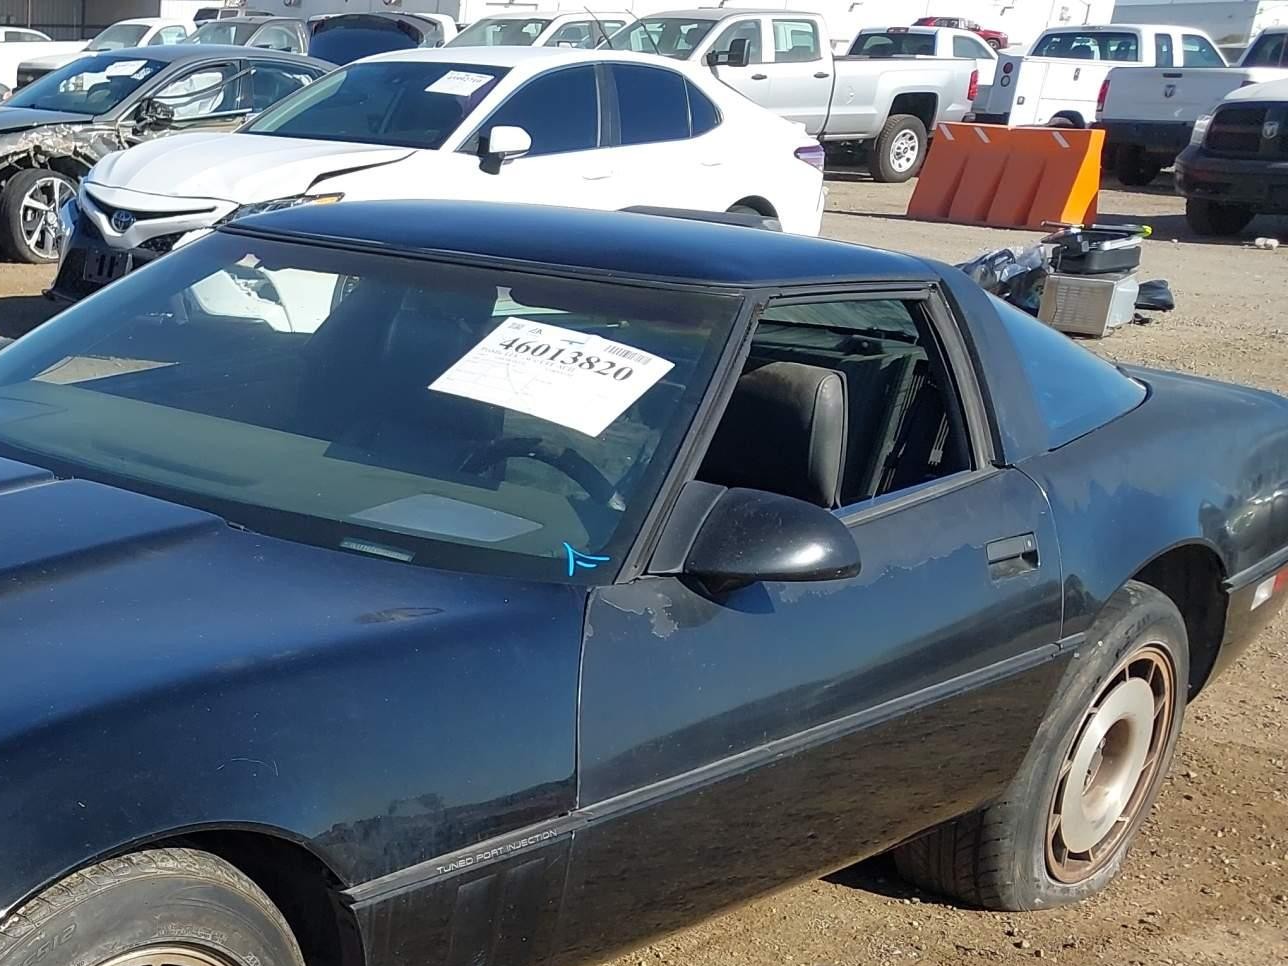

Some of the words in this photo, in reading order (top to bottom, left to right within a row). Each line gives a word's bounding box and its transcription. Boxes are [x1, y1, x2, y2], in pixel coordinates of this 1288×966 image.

[498, 336, 634, 381] 46013820
[436, 856, 474, 875] TUNED
[476, 846, 504, 863] PORT
[506, 828, 558, 854] INJECTION
